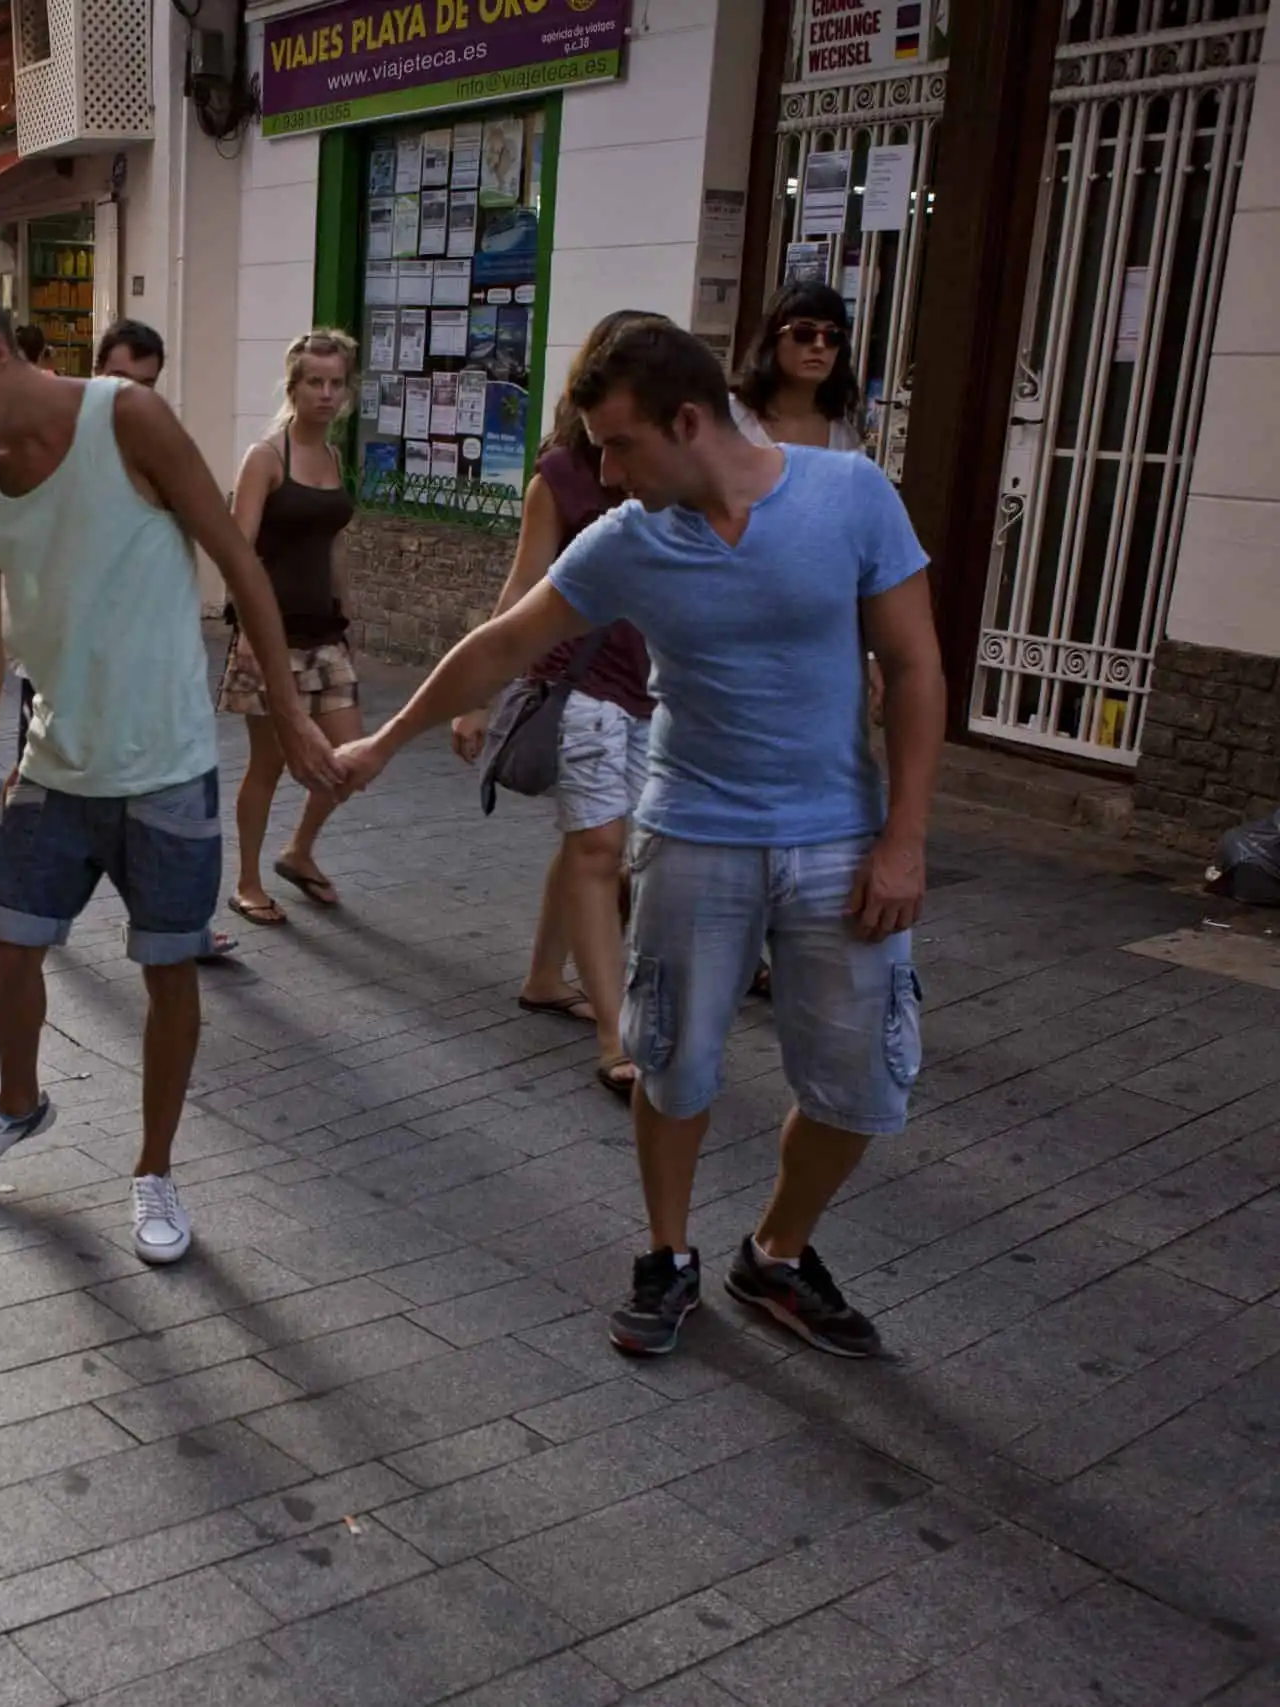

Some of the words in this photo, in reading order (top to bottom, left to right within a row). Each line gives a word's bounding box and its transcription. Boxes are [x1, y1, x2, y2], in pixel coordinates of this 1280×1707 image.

[270, 22, 344, 73] VIAJES
[350, 2, 427, 54] PLAYA
[436, 0, 468, 34] DE
[810, 9, 882, 46] EXCHANGE
[327, 42, 488, 90] www.viajeteca.es
[809, 40, 872, 73] WECHSEL
[456, 57, 607, 98] info@viajeteca.es
